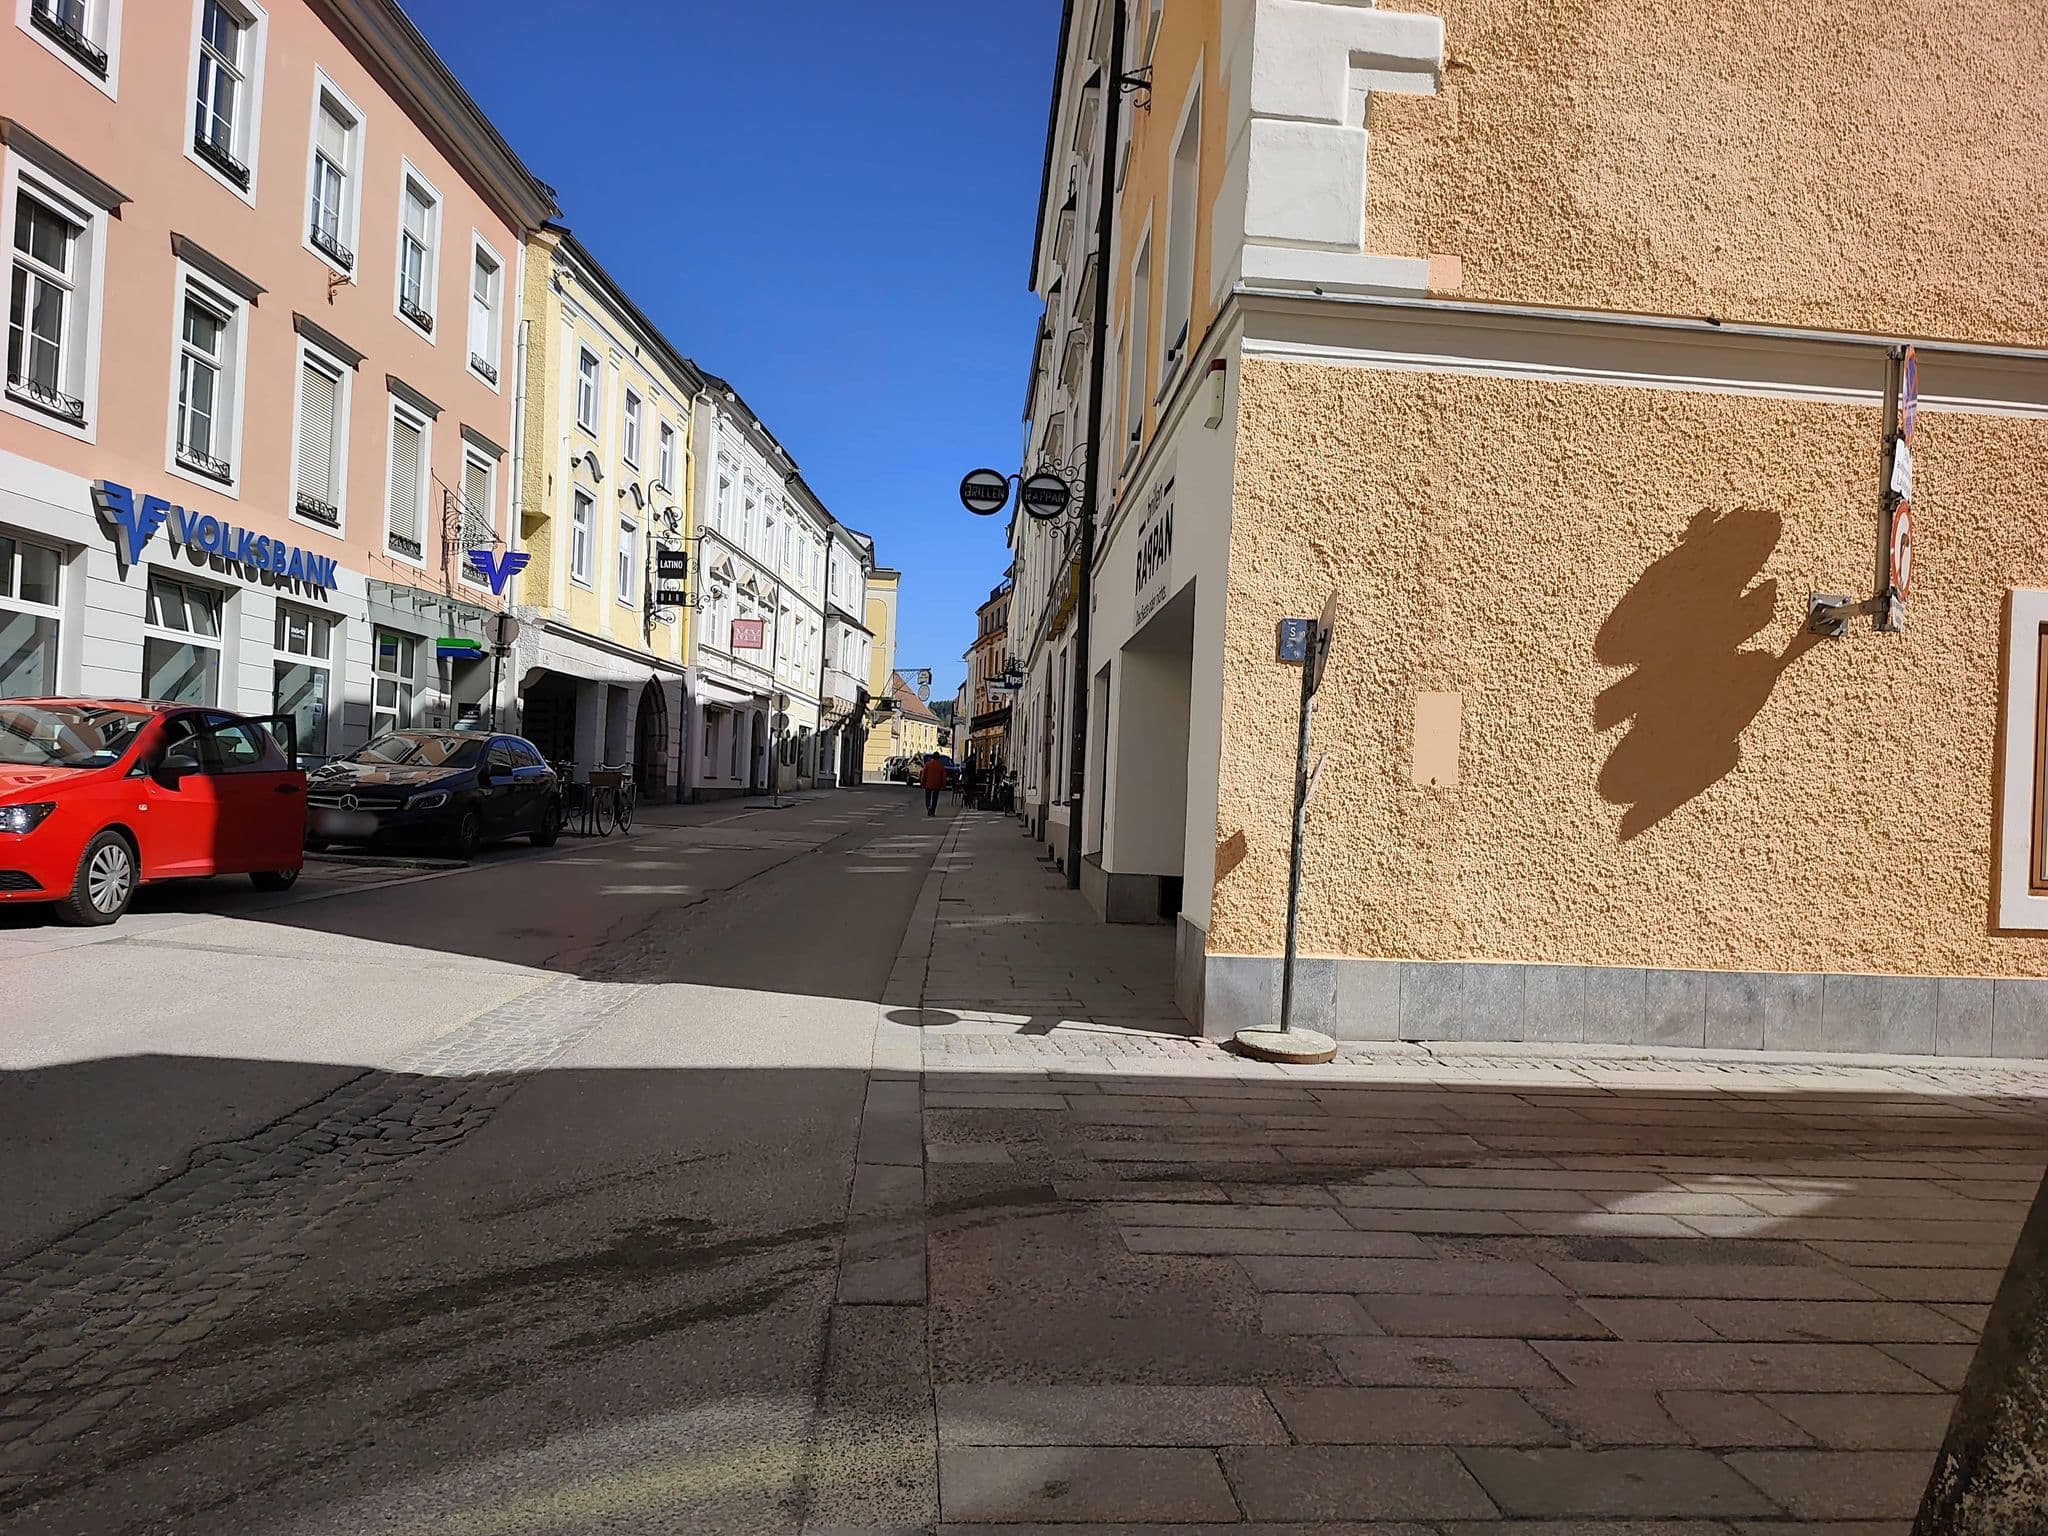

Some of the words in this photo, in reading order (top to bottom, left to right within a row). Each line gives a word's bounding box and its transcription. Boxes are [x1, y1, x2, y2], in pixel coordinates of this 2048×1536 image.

[177, 505, 338, 590] VOLKSBANK
[660, 559, 683, 569] LATINO
[1004, 674, 1022, 686] Tips
